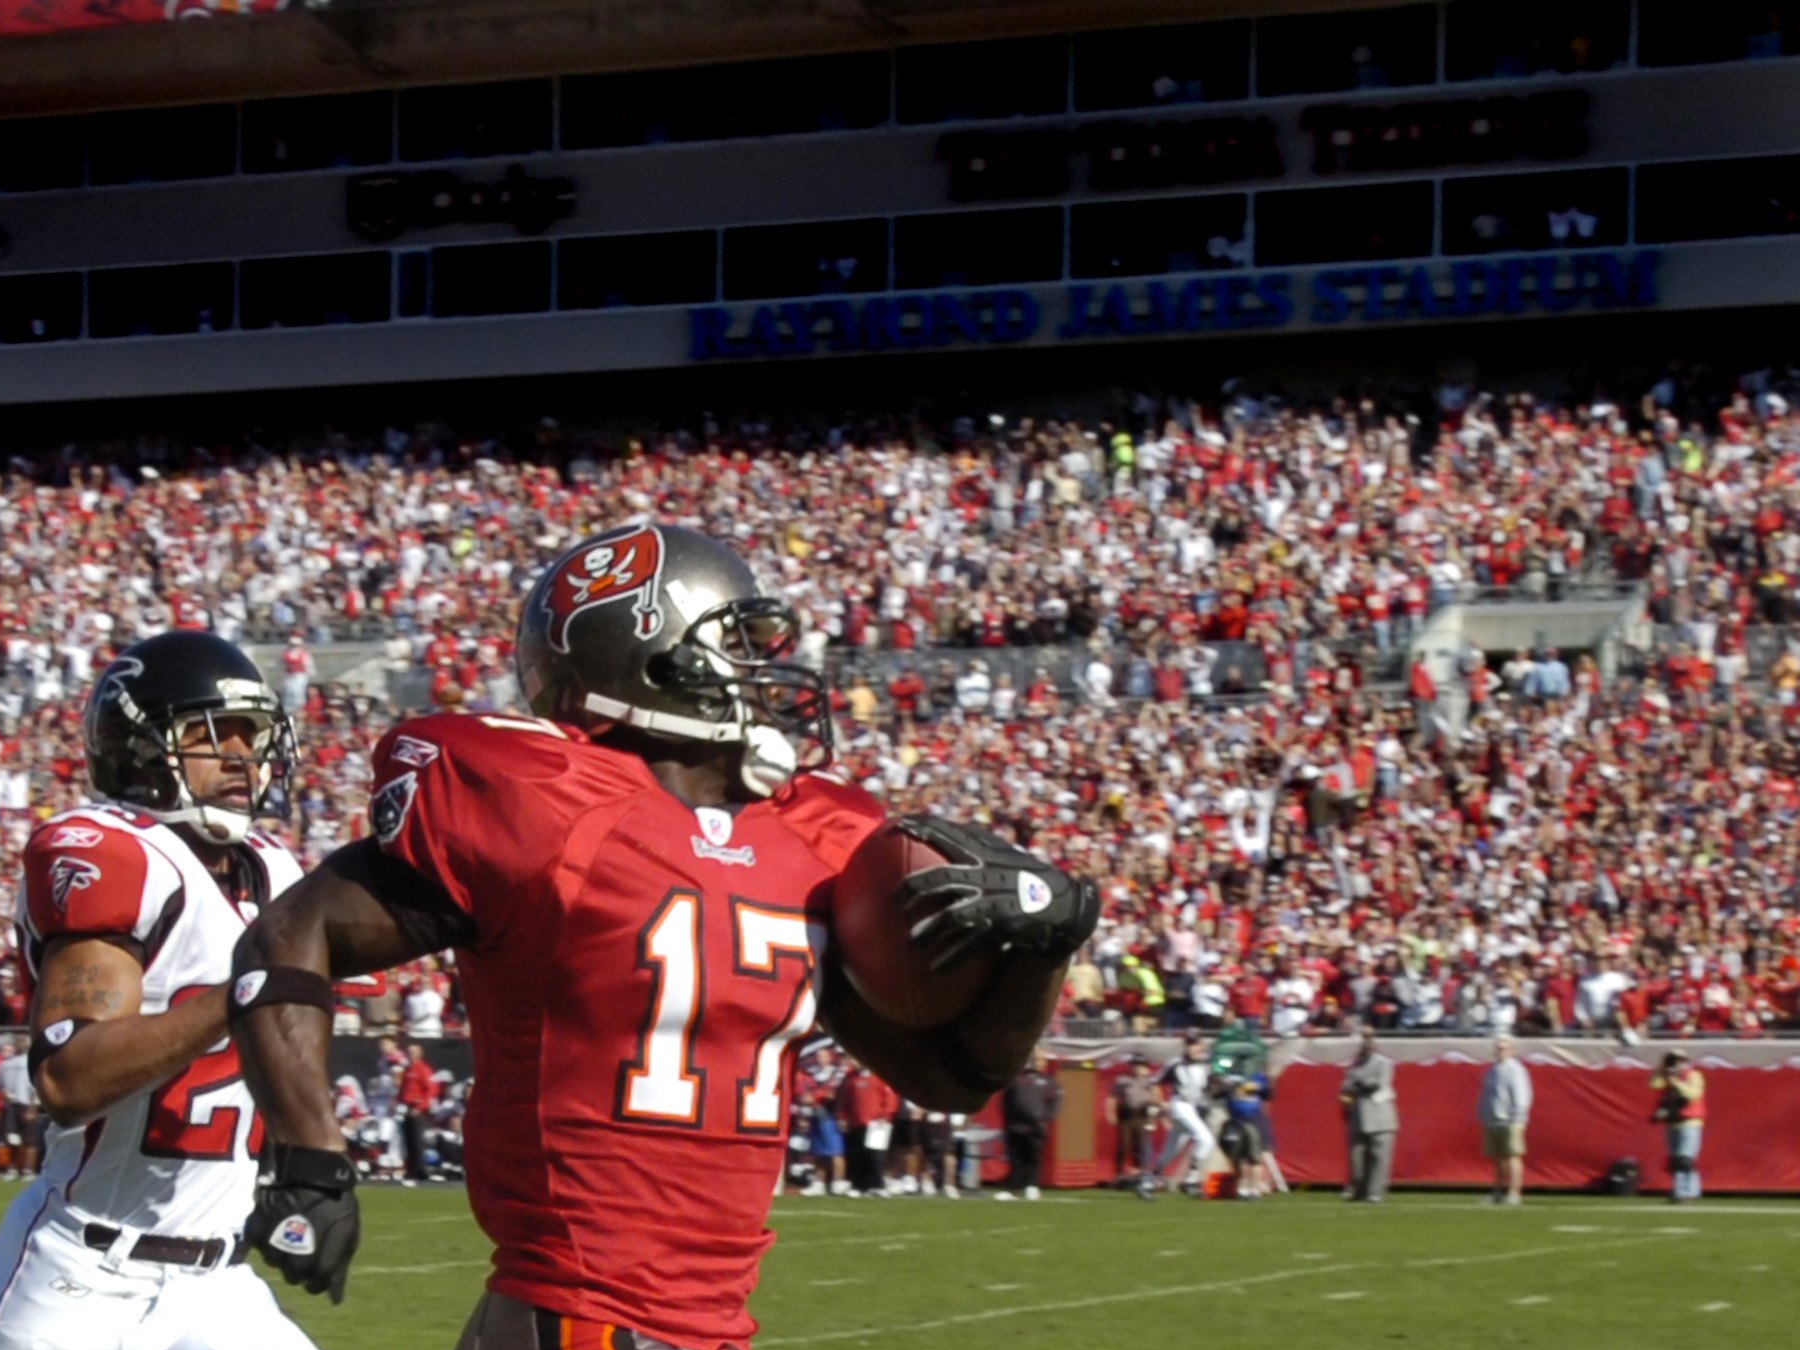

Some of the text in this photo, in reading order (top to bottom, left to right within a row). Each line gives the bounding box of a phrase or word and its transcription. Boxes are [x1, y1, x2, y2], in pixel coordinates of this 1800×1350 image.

[689, 249, 1660, 360] RAYMOND JAMES STADIUM
[141, 984, 265, 1161] 2
[614, 885, 822, 1132] 17
